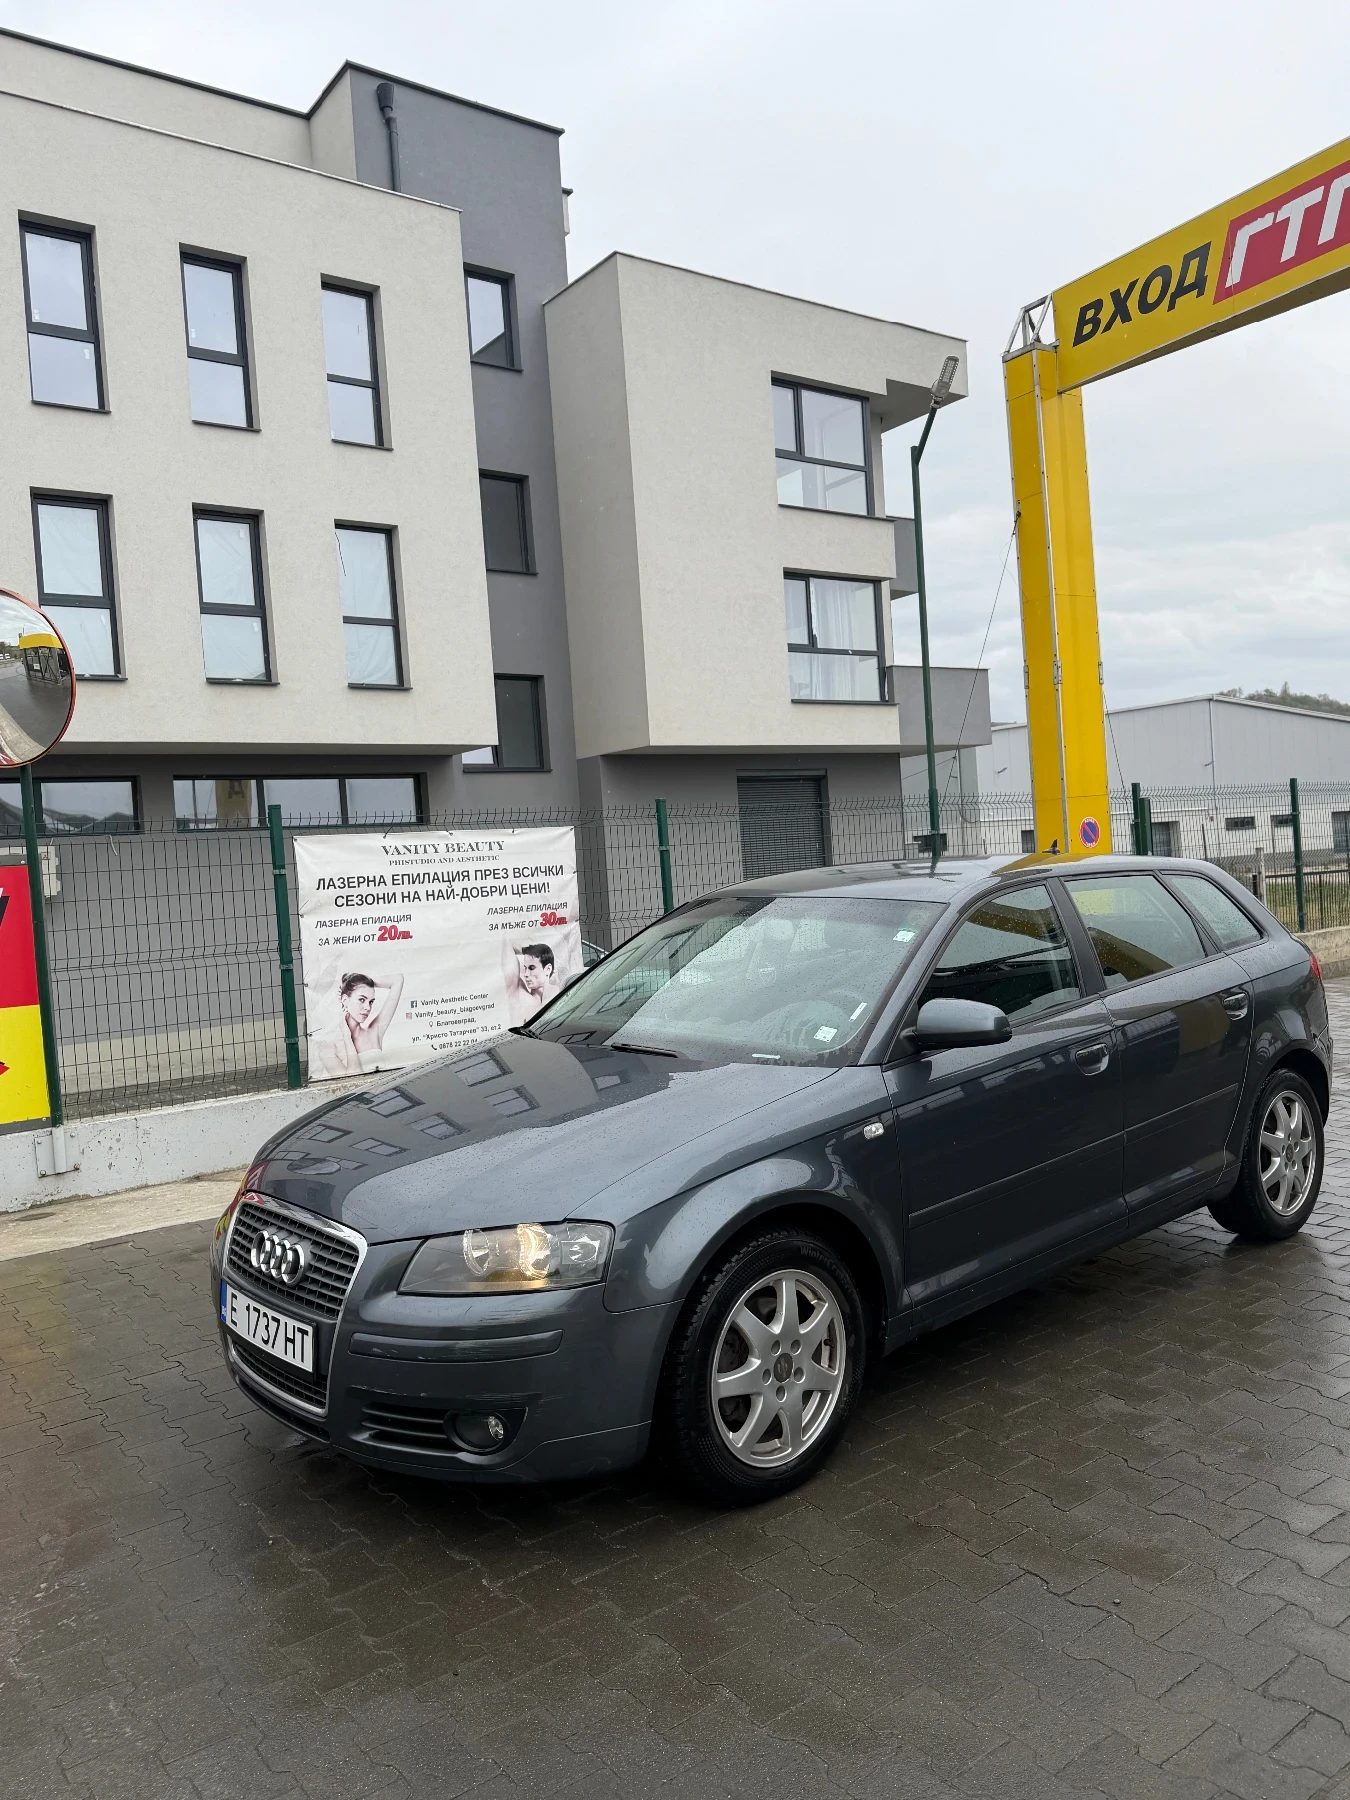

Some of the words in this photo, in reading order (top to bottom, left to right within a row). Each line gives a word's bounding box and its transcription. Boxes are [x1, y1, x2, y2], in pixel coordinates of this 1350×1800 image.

[1072, 241, 1212, 347] ВХОД
[381, 843, 440, 856] VANITY
[444, 840, 505, 853] BEAUTY
[455, 855, 500, 863] AESTHETIC
[316, 875, 387, 891] ЛАЗЕРНА
[391, 870, 470, 886] ЕПИЛАЦИЯ
[474, 867, 509, 881] ПРЕЗ
[512, 865, 564, 878] ВСИЧКИ
[334, 892, 397, 908] СЕЗОНИ
[401, 890, 421, 903] НА
[425, 885, 507, 902] НАЙ-ДОБРИ
[511, 882, 550, 898] ЦЕНИ!
[487, 906, 524, 916] ЛАЗЕРНА
[525, 902, 568, 912] ЕПИЛАЦИЯ
[315, 918, 359, 929] ЛАЗЕРНА
[361, 914, 412, 925] ЕПИЛАЦИЯ
[488, 923, 499, 931] ЗА
[501, 921, 526, 930] МЪЖЕ
[527, 919, 539, 928] ОТ
[318, 937, 330, 946] ЗА
[332, 935, 361, 945] ЖЕНИ
[363, 933, 376, 943] ОТ
[420, 998, 439, 1006] Vanity
[440, 995, 468, 1004] Aesthetic
[231, 1291, 238, 1328] E
[245, 1302, 281, 1349] 1737
[284, 1321, 309, 1364] HT
